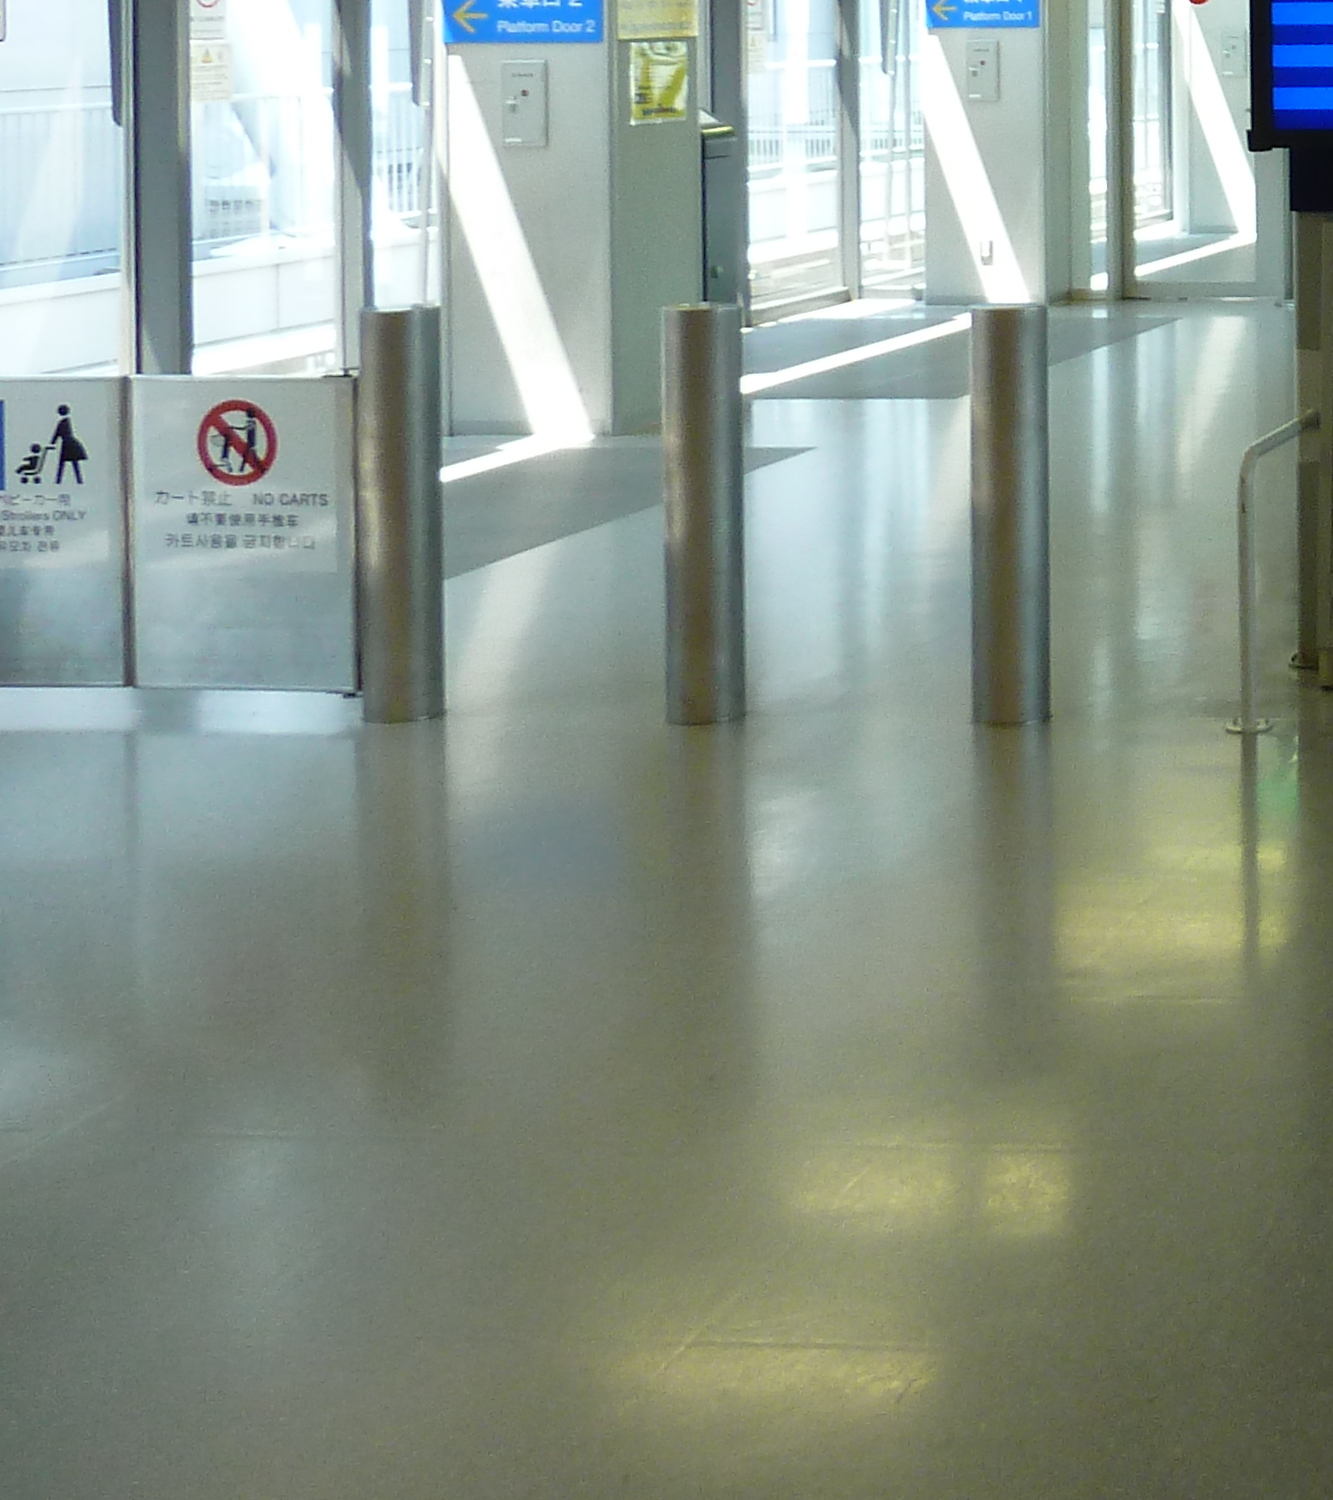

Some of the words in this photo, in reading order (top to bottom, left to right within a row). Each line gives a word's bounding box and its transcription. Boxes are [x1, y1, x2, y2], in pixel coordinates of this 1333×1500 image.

[496, 21, 551, 33] Platform
[552, 21, 583, 33] Door
[586, 20, 596, 33] 2
[155, 490, 232, 506] カート禁止
[252, 493, 275, 506] NO
[280, 493, 329, 506] CARTS
